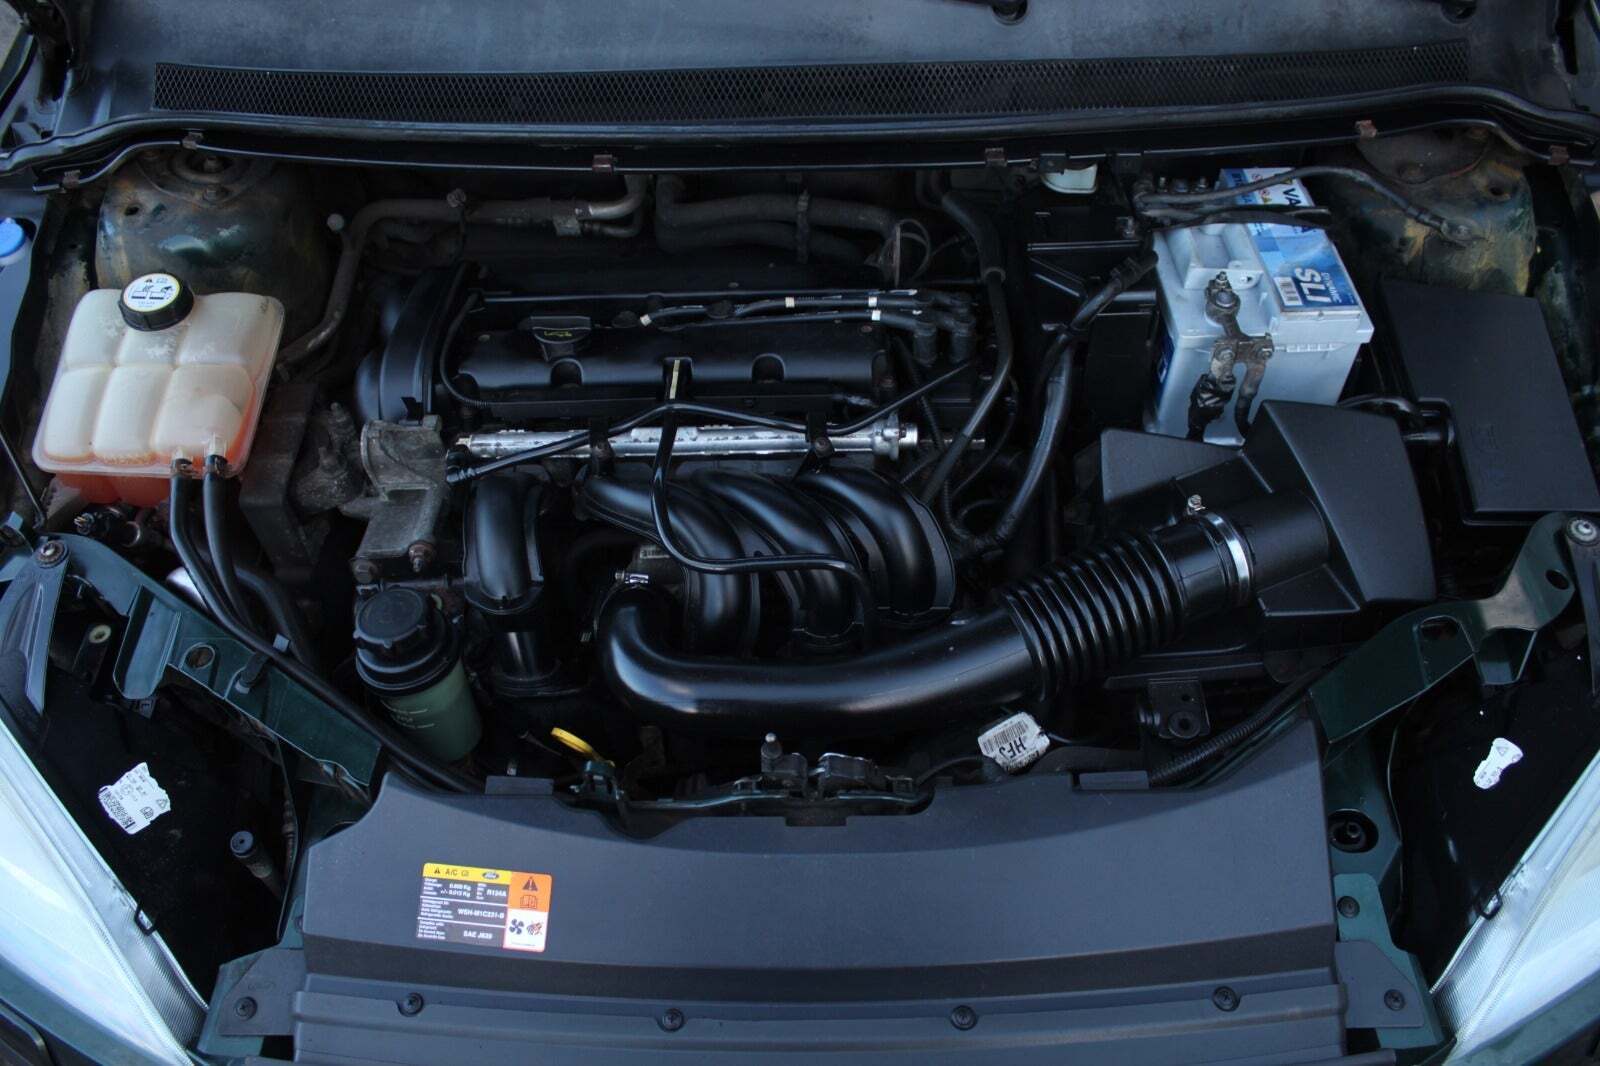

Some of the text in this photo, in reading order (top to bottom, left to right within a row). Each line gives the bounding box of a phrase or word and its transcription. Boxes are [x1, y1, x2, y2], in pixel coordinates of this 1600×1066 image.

[1294, 267, 1333, 304] SLI
[999, 736, 1026, 761] HFJ
[486, 889, 507, 898] R134A
[463, 930, 477, 938] SAE
